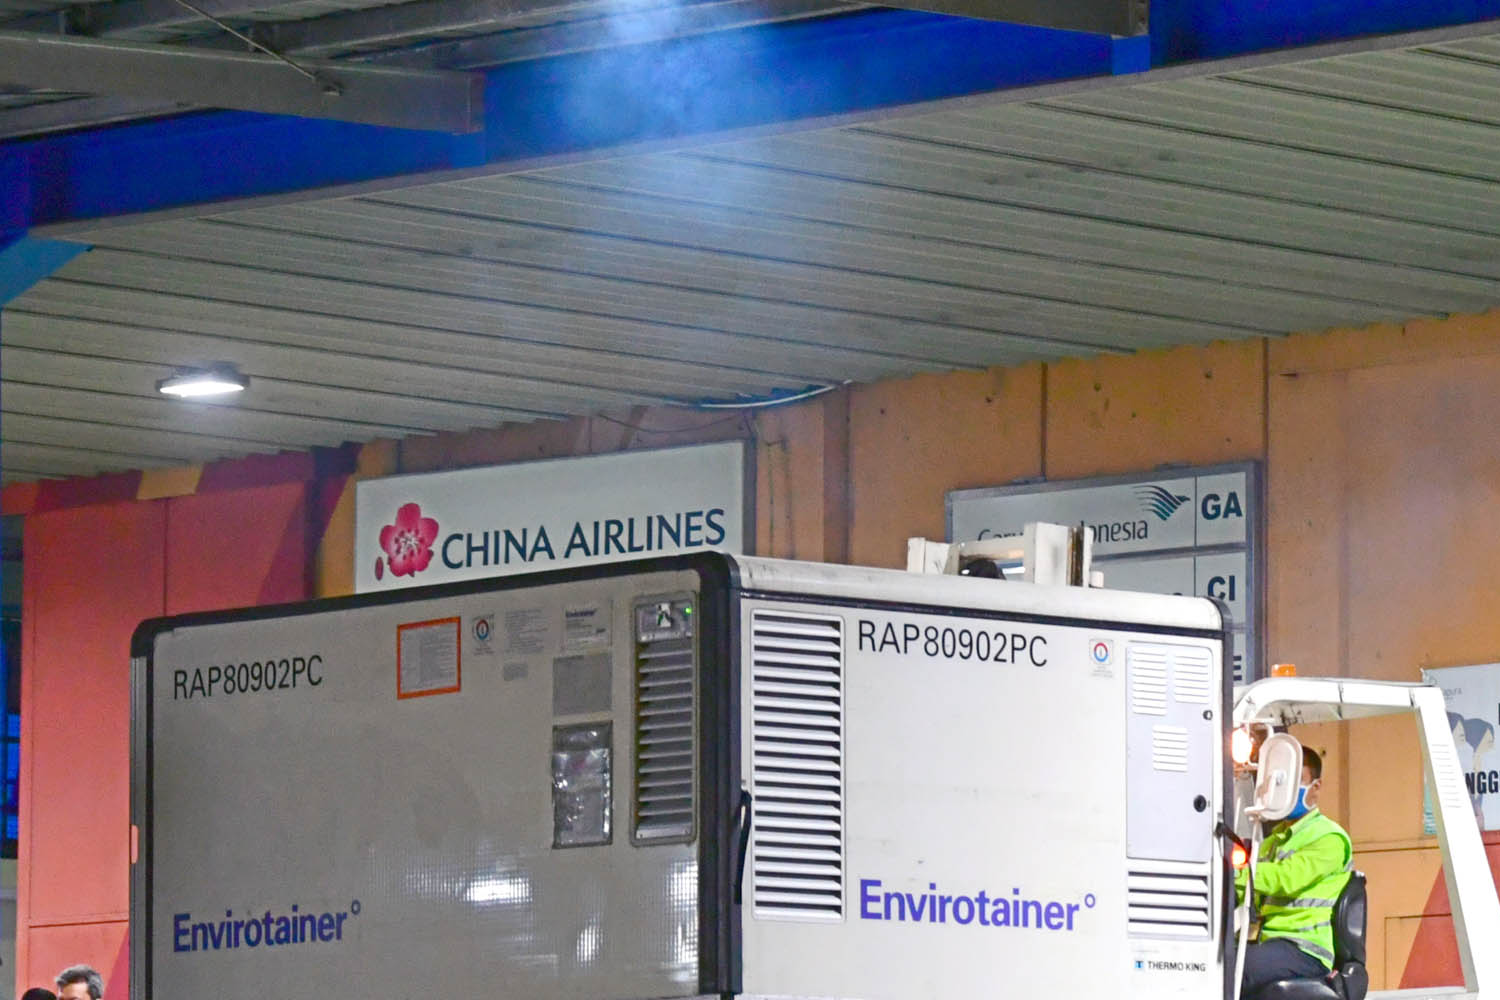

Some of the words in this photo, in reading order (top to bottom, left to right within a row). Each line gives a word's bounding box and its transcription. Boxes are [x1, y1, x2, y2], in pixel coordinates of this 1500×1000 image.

[1201, 492, 1242, 520] GA
[441, 525, 556, 569] CHINA
[564, 508, 726, 558] AIRLINES
[1207, 575, 1235, 601] CI
[858, 620, 1047, 667] RAP80902PC
[174, 655, 322, 700] RAP80902PC
[1147, 960, 1184, 971] THERMO
[1186, 962, 1206, 972] KING
